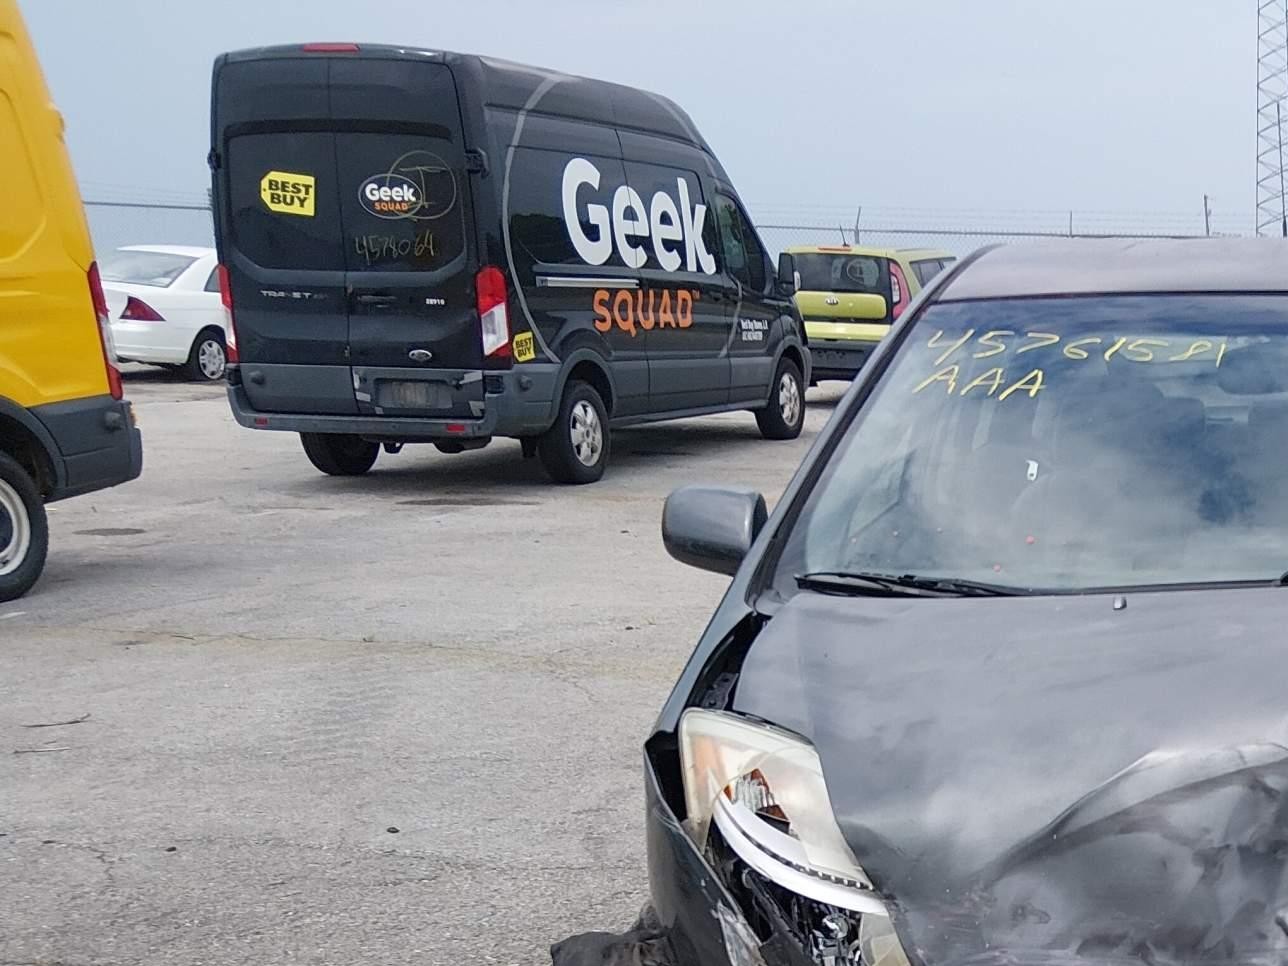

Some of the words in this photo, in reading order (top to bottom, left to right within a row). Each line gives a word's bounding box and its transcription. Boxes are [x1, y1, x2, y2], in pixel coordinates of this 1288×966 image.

[268, 179, 313, 196] BEST
[365, 182, 417, 202] Geek
[270, 192, 308, 208] BUY
[373, 201, 409, 212] SQUAD
[561, 157, 717, 276] Geek
[592, 289, 693, 337] SQUAD
[515, 336, 532, 349] BEST
[927, 328, 1226, 369] 45761581
[517, 346, 531, 358] BUY
[911, 364, 1046, 401] AAA
